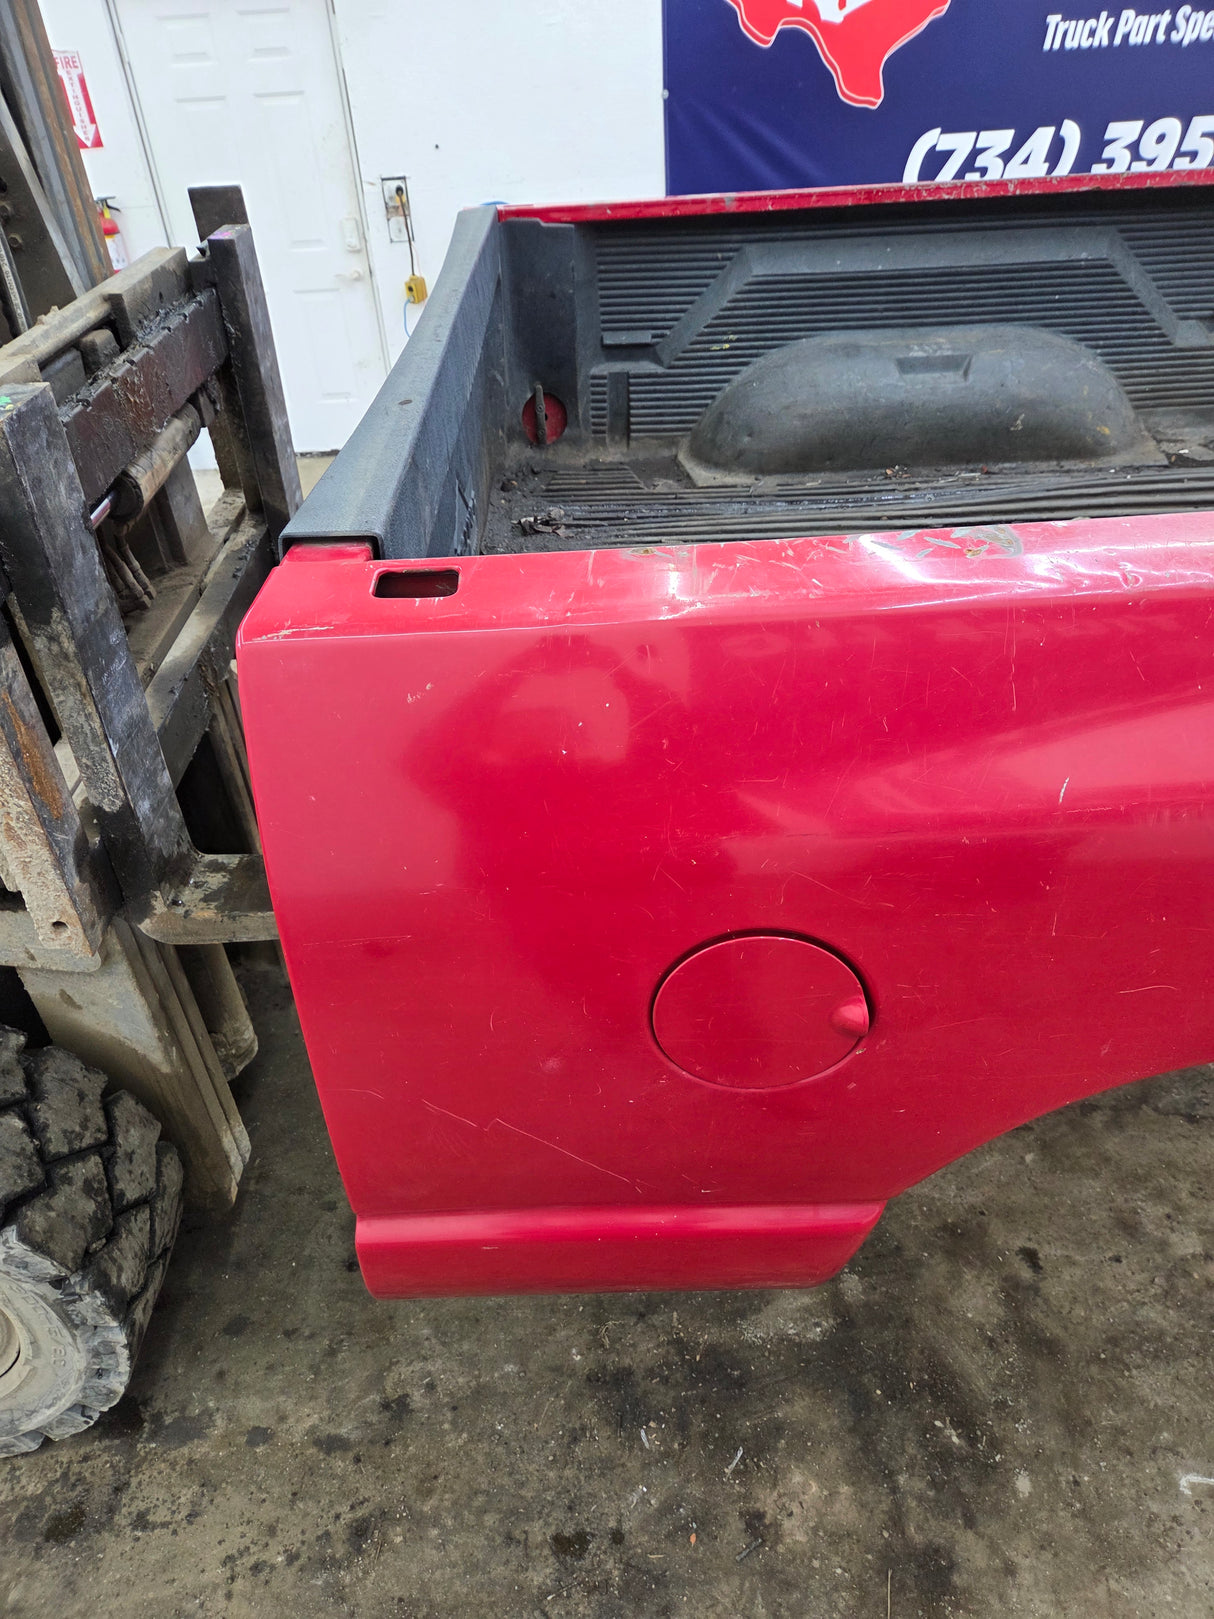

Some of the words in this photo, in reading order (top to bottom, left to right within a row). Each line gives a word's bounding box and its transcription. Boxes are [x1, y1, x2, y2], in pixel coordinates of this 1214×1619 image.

[1043, 10, 1115, 52] Truck
[1113, 9, 1172, 47] Part
[54, 55, 79, 70] FIRE
[66, 70, 90, 141] EXTINGUISHER
[902, 118, 1081, 183] (734)
